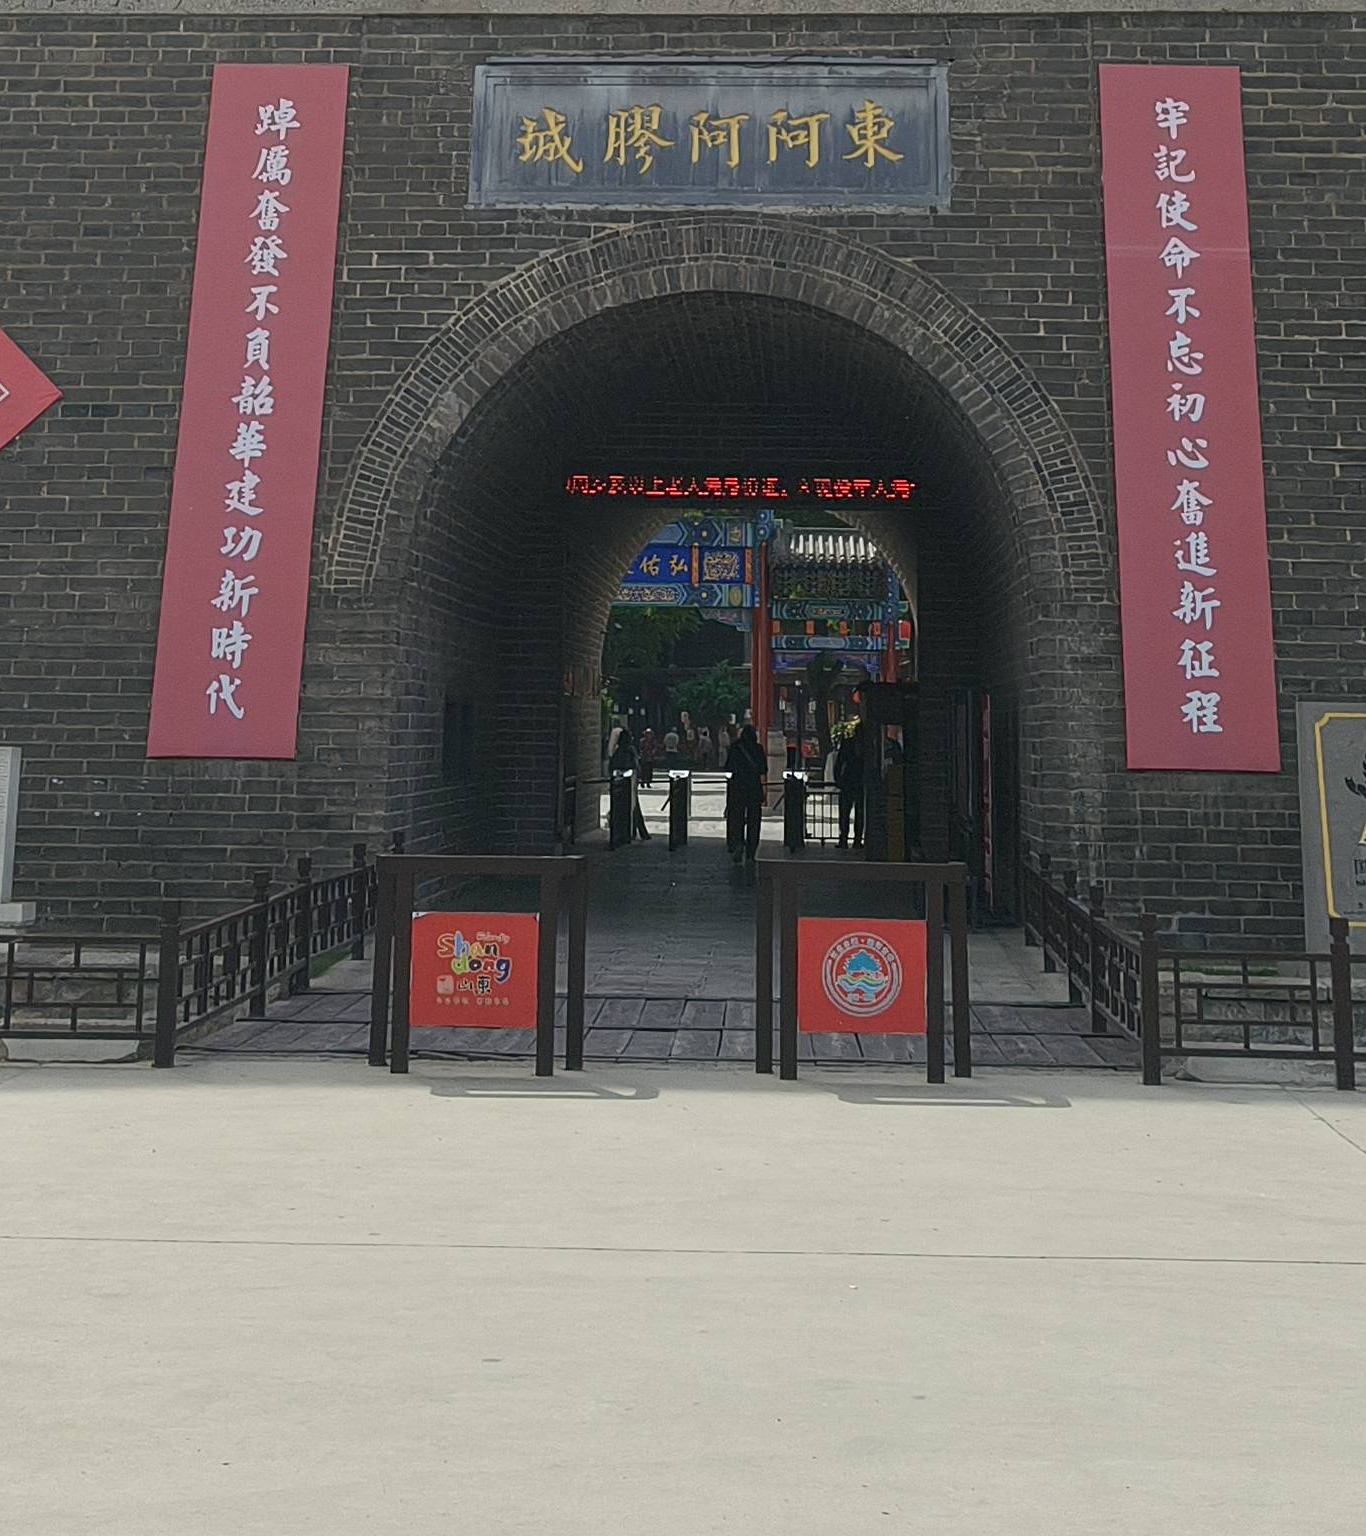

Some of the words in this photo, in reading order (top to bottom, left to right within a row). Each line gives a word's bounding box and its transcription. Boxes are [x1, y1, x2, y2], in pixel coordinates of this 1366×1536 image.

[205, 97, 302, 720] 踔厲奮發不負韶華建功新時代
[1152, 96, 1224, 734] 牢記使命不忘初心奮進新征程
